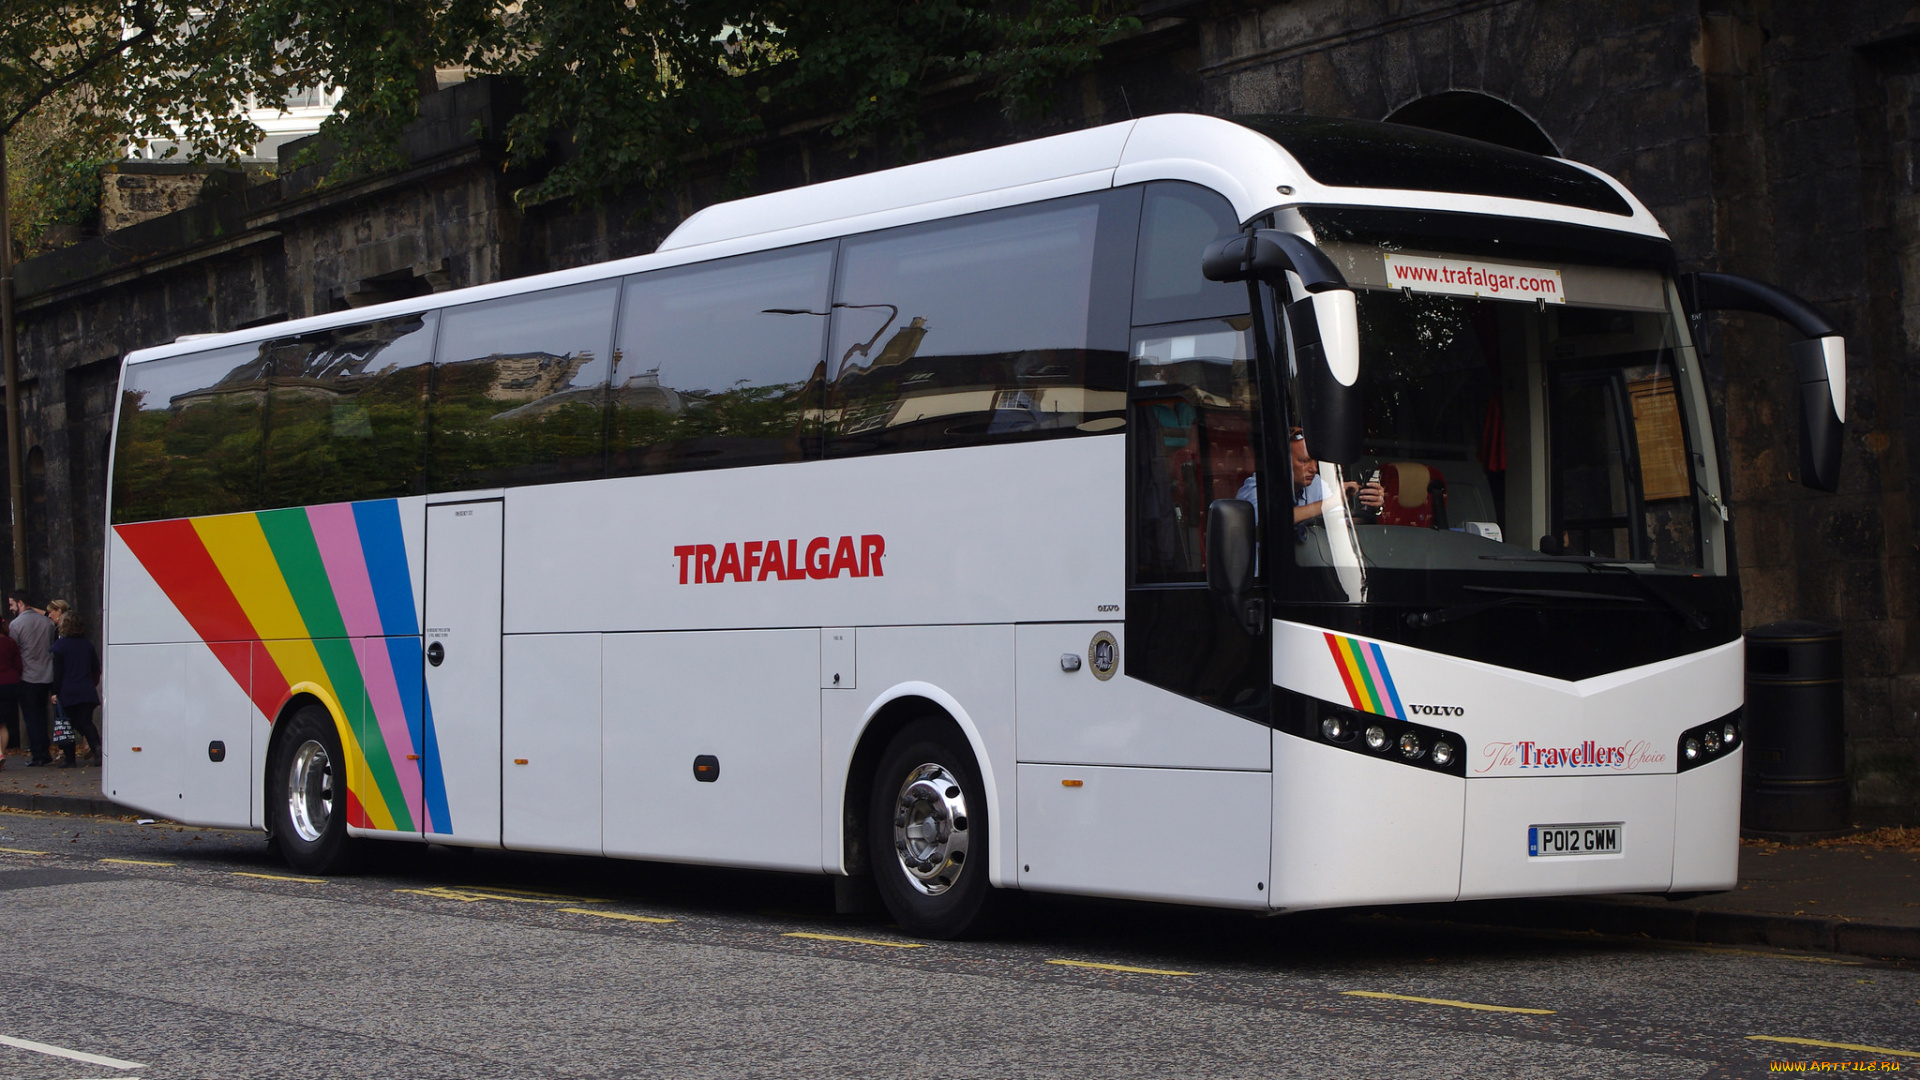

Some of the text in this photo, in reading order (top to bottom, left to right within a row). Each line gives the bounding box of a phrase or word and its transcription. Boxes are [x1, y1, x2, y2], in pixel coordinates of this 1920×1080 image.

[1394, 264, 1557, 294] www.trafalgar.com
[674, 534, 886, 585] TRAFALGAR
[1409, 704, 1465, 717] VOLVO
[1474, 739, 1667, 773] The Travellers Choice
[1543, 829, 1616, 851] PO12 GWM
